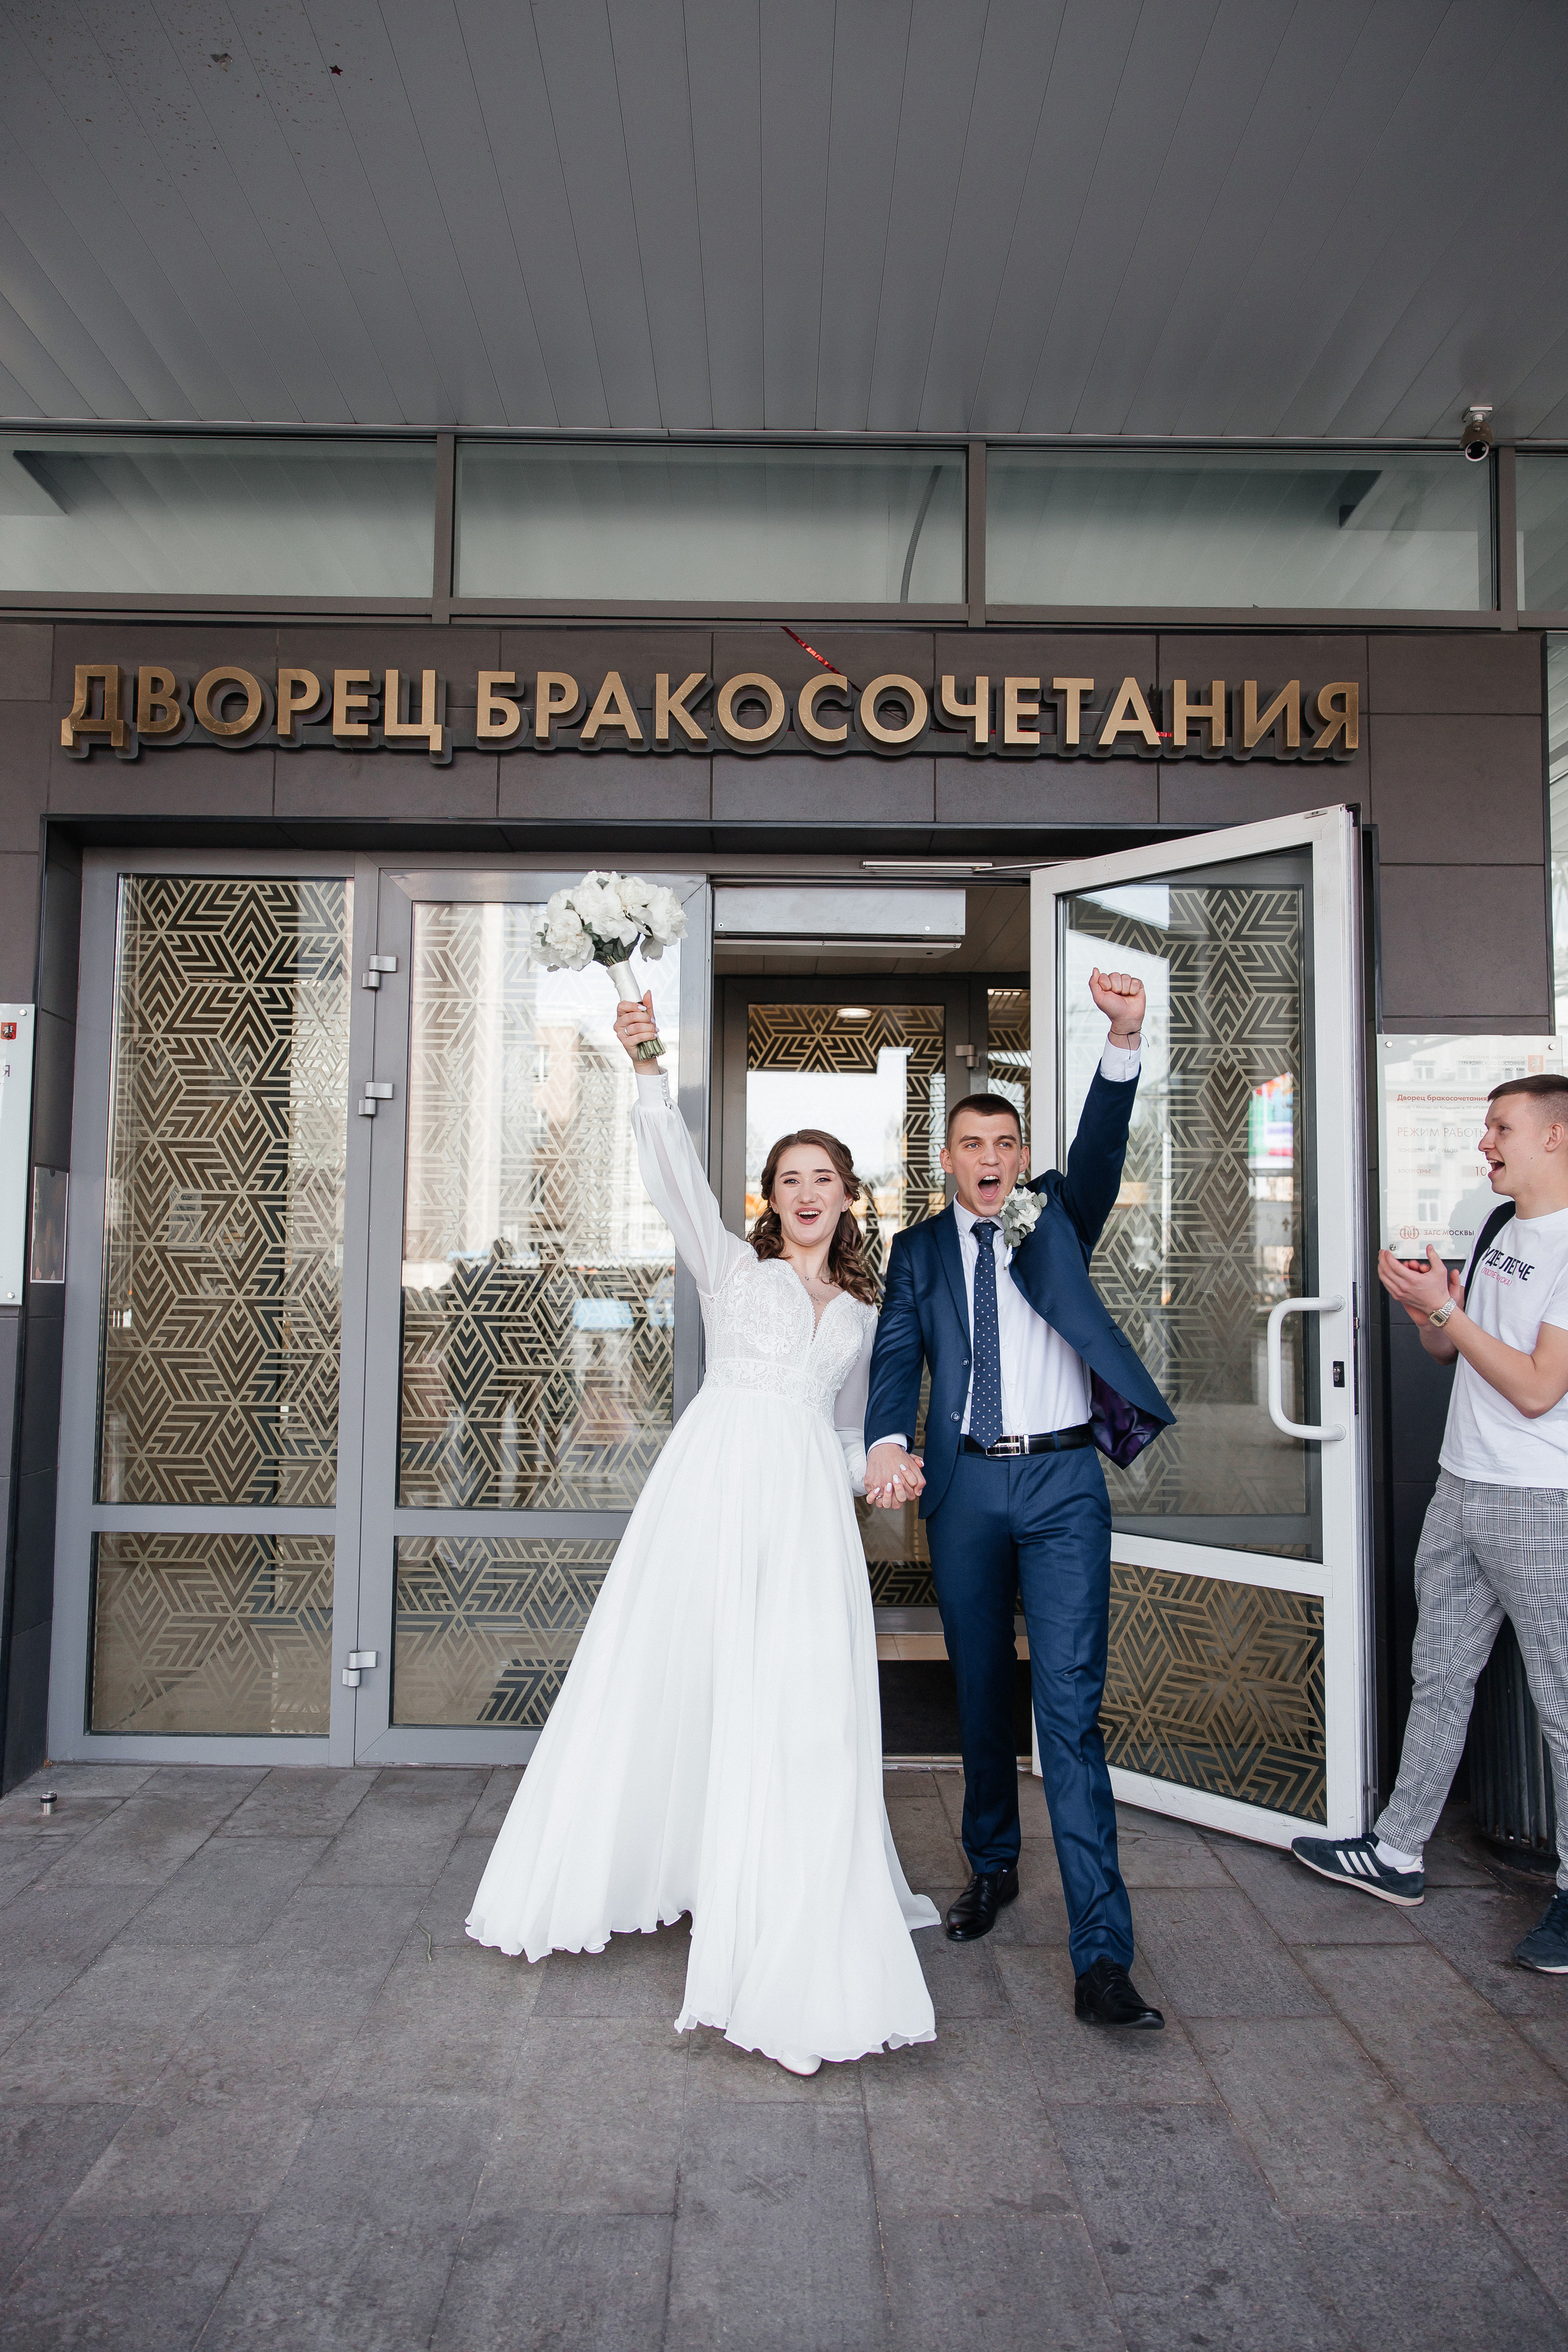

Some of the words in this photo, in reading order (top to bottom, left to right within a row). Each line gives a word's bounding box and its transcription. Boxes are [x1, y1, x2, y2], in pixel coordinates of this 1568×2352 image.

[61, 665, 448, 755] ДВОРЕЦ
[476, 671, 1360, 751] БРАКОСОЧЕТАНИЯ
[1397, 1128, 1439, 1137] РЕЖИМ
[1476, 1166, 1488, 1176] 10
[1499, 1256, 1535, 1281] ЛЕГЧЕ
